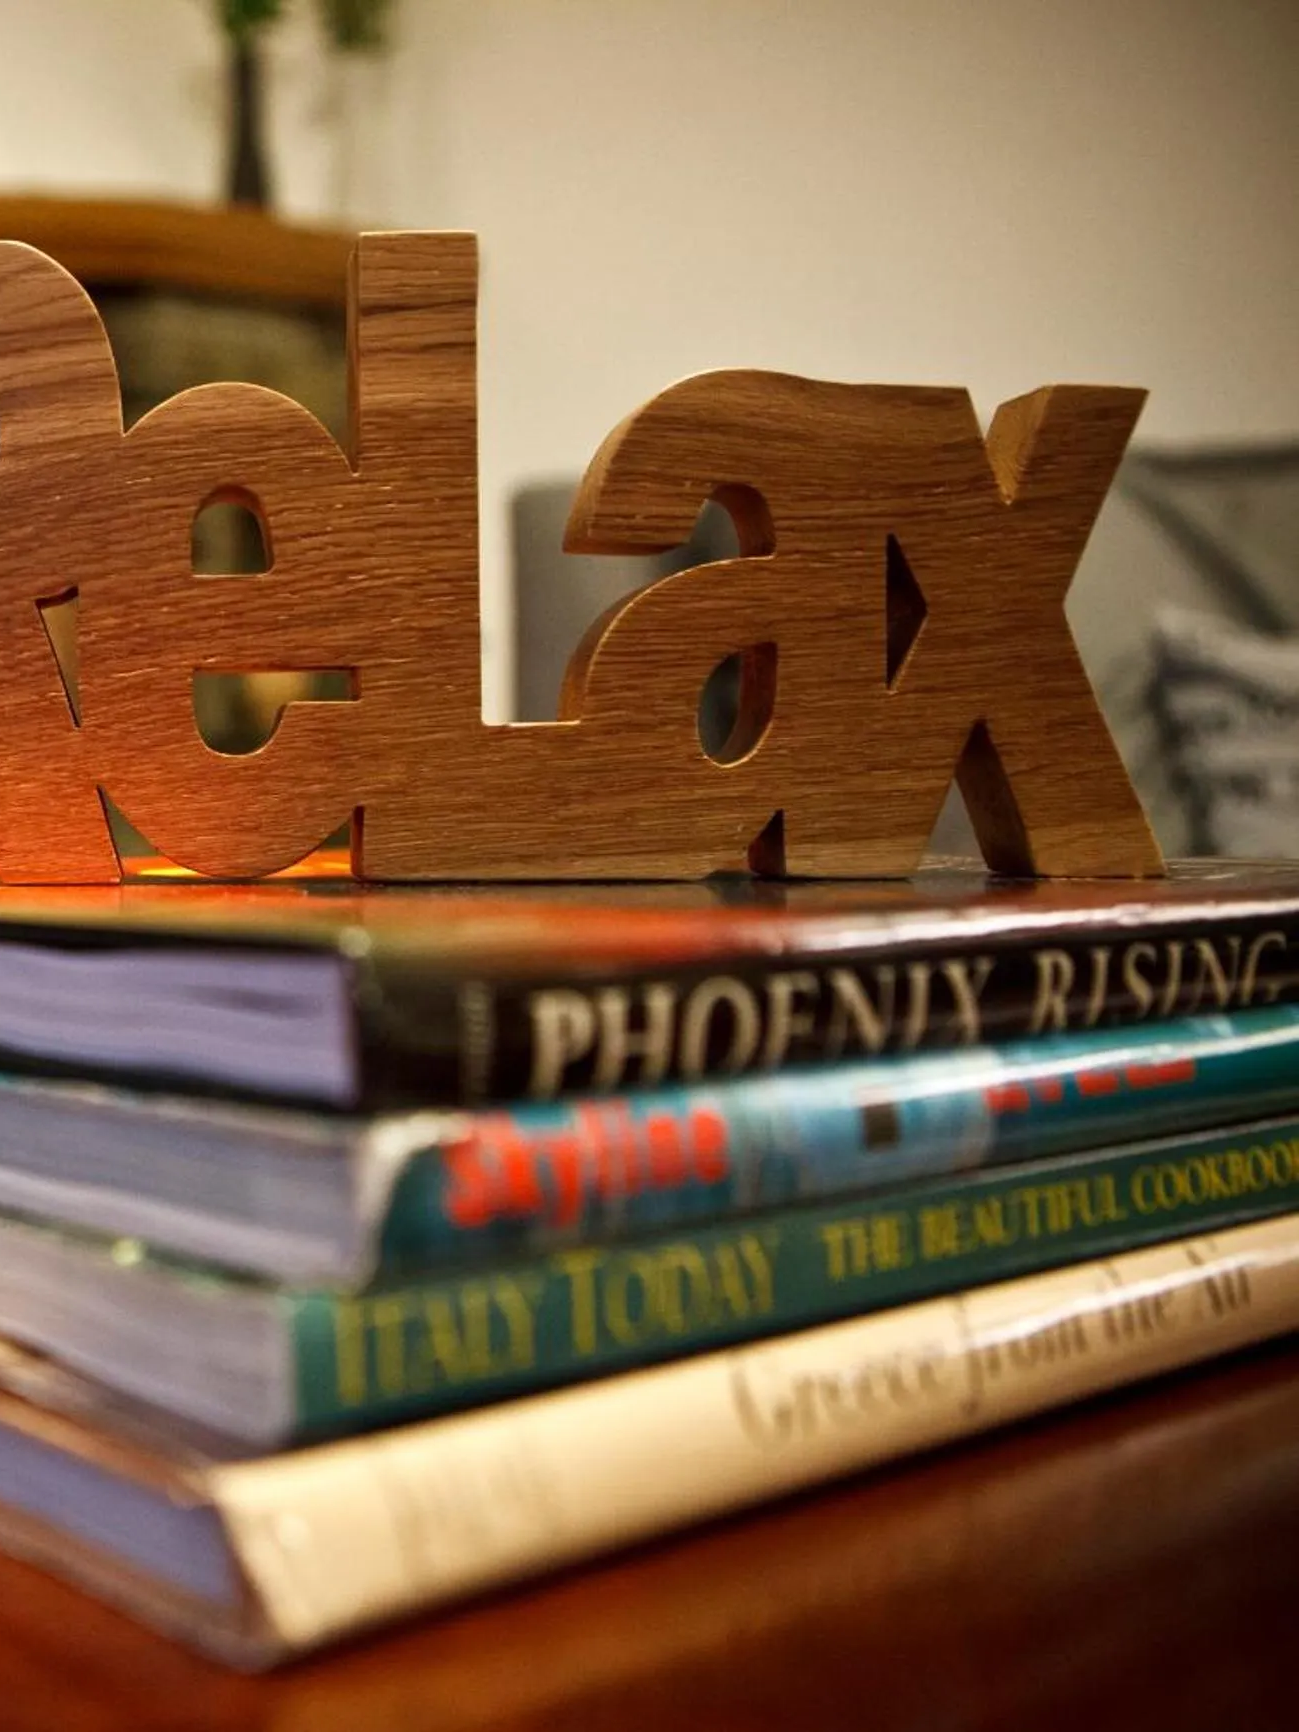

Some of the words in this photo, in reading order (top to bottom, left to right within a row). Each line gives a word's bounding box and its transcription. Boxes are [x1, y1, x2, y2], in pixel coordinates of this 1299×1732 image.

[529, 956, 997, 1100] PHOENIX
[1029, 931, 1288, 1034] RISING
[822, 1218, 909, 1281] THE
[917, 1176, 1125, 1258] BEAUTIFUL
